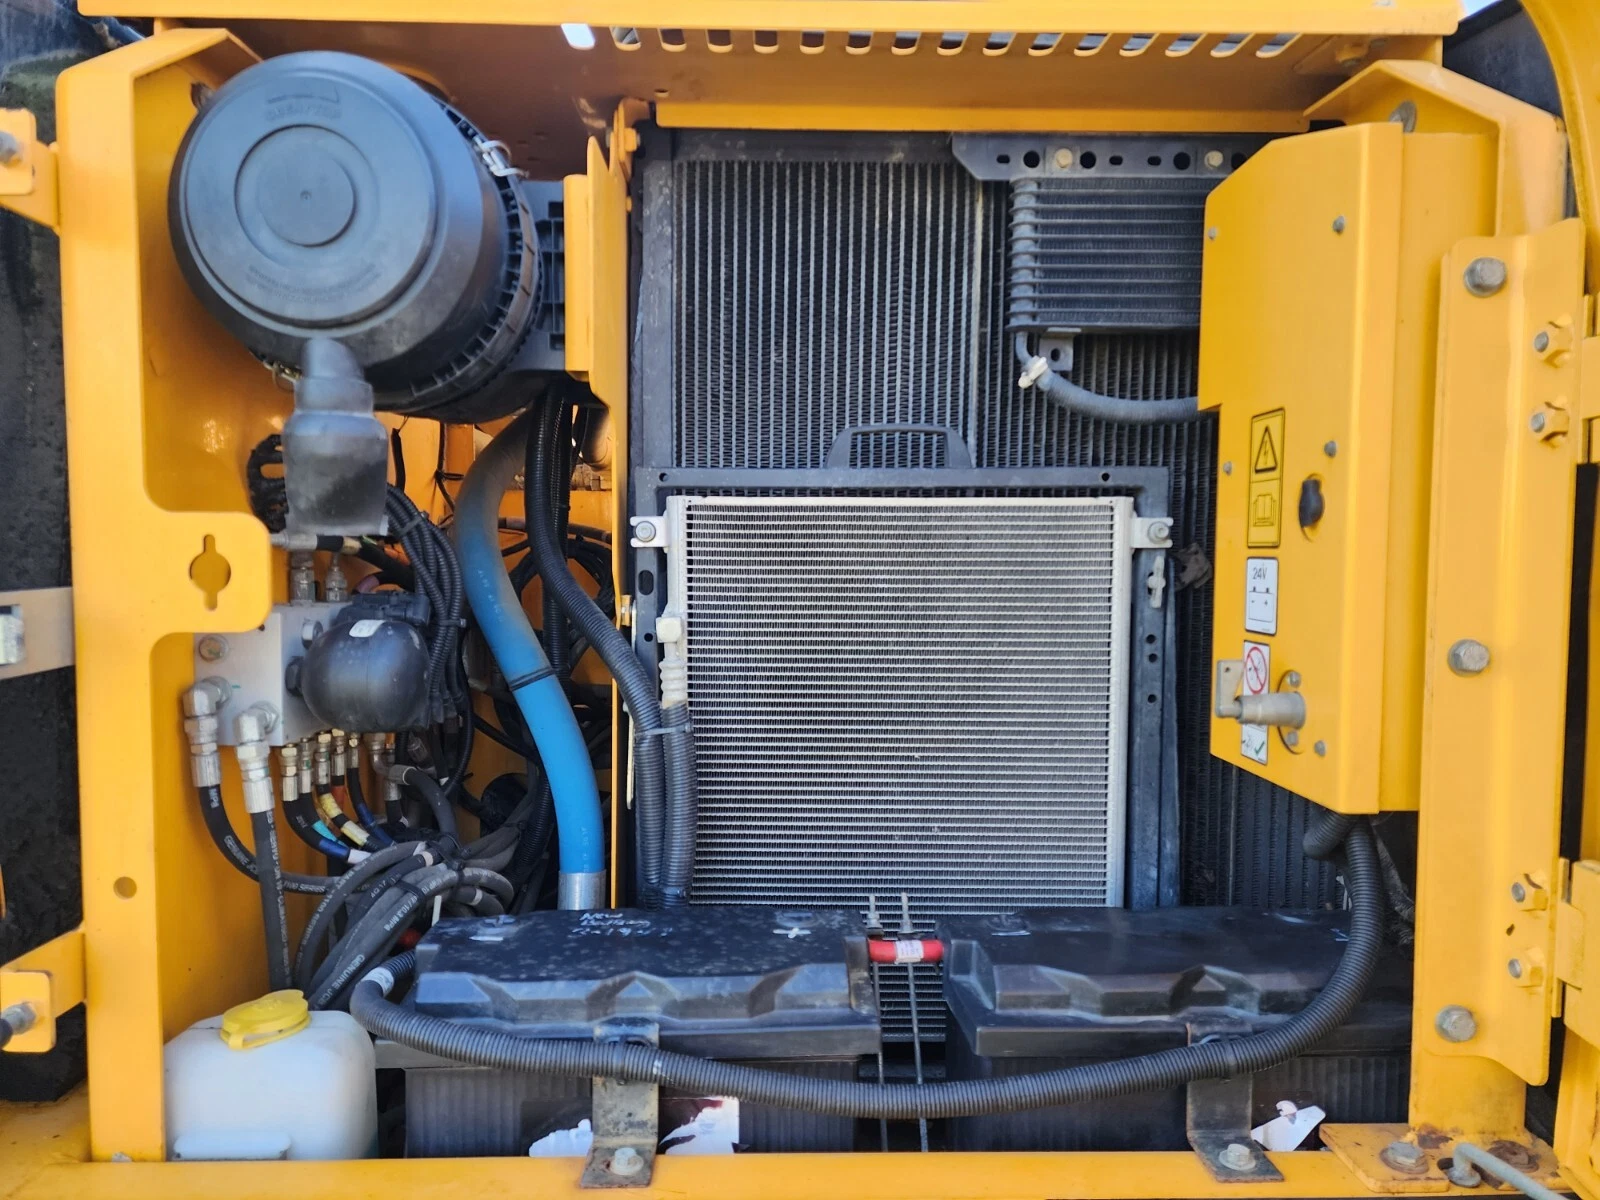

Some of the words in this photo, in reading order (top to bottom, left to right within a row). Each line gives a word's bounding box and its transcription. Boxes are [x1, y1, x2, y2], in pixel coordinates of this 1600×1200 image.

[1252, 567, 1268, 580] 24V
[331, 953, 366, 990] GENUINE
[318, 988, 335, 1005] JCB
